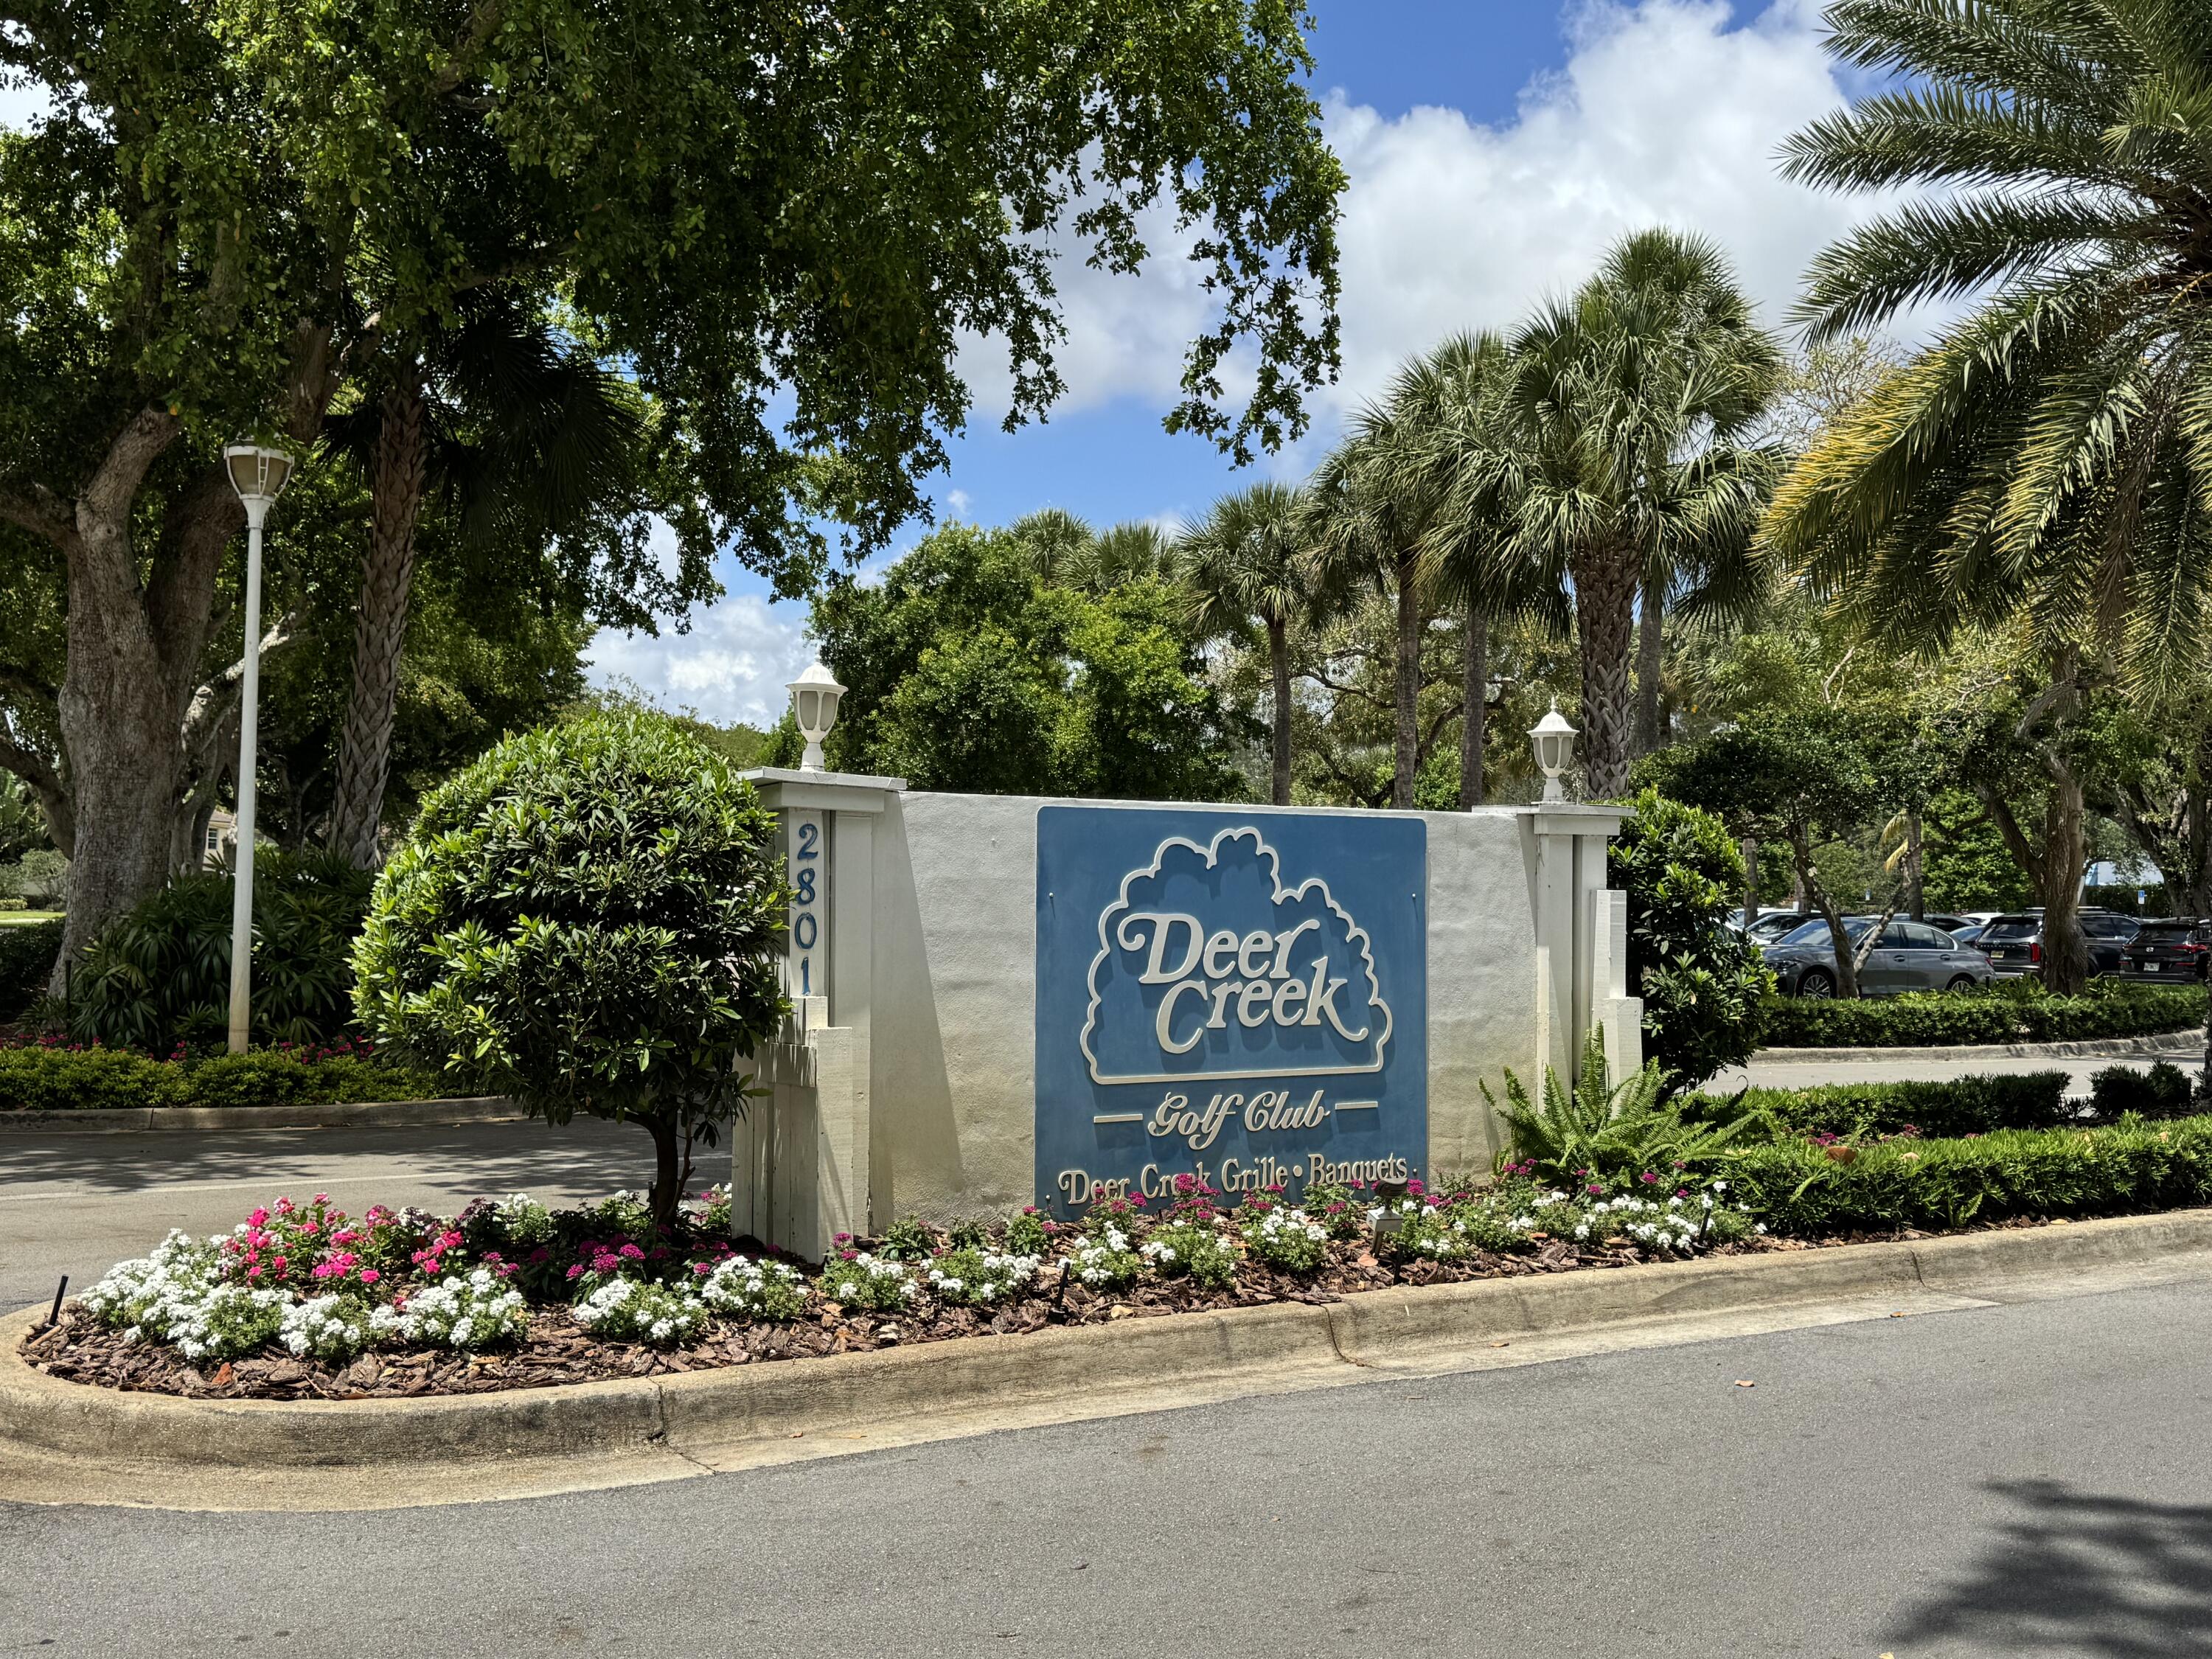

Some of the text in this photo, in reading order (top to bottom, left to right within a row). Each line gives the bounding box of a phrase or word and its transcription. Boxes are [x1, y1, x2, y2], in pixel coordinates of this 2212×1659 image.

[795, 823, 818, 995] 28801
[1117, 913, 1320, 984] Deer
[1156, 956, 1368, 1054] Creek
[1147, 1090, 1330, 1150] Golf Club
[1058, 1152, 1408, 1204] Deer Crek Grille Banquets
